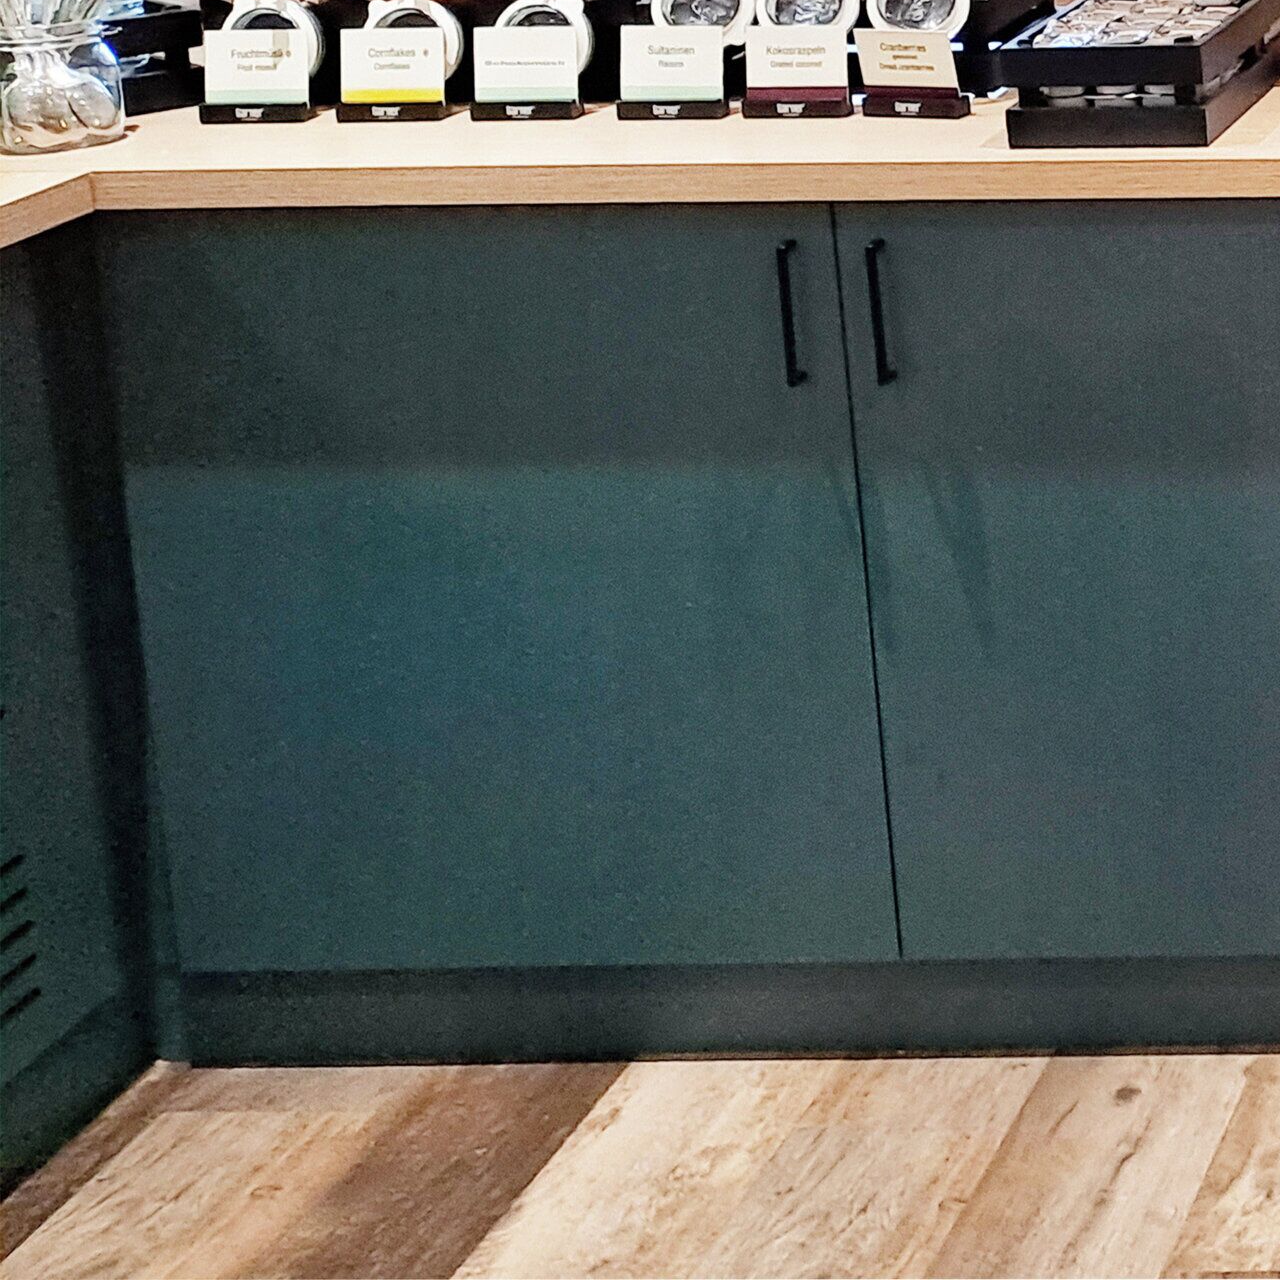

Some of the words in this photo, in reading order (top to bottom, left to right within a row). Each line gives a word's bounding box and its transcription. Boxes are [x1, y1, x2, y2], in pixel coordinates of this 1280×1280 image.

[368, 47, 416, 58] Cornflakes
[647, 44, 696, 55] Sultaninen
[766, 45, 826, 56] Kokosraspeln
